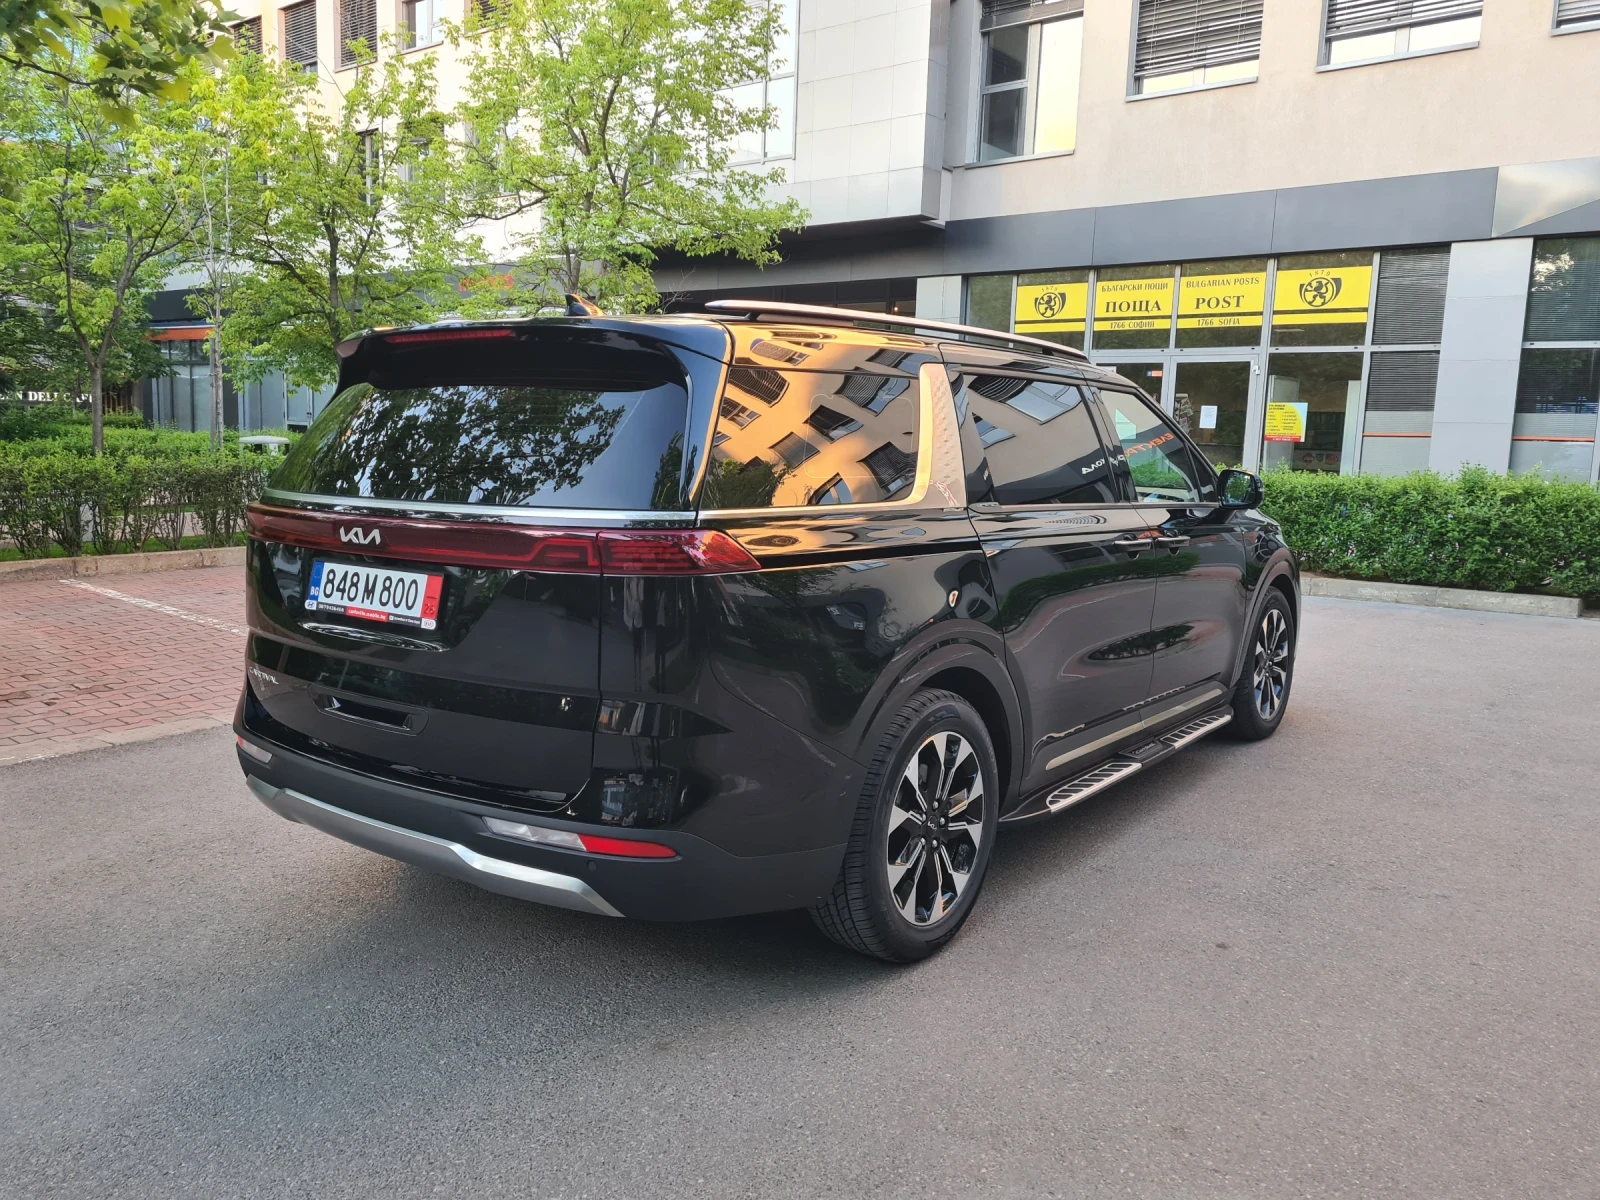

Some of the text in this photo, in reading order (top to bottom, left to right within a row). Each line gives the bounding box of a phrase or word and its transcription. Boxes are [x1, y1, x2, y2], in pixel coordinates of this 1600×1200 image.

[1101, 282, 1168, 292] БЪЛГАРСКИ ПОЩИ
[1186, 277, 1260, 288] BULGARIAN POSTS
[1105, 299, 1161, 313] ПОЩА
[1194, 295, 1245, 310] POST
[1110, 320, 1155, 329] 1766 СОФИЯ
[1197, 317, 1240, 327] 1766 SOFIA
[339, 526, 381, 545] KIA
[310, 586, 320, 596] BG
[424, 603, 435, 615] 26
